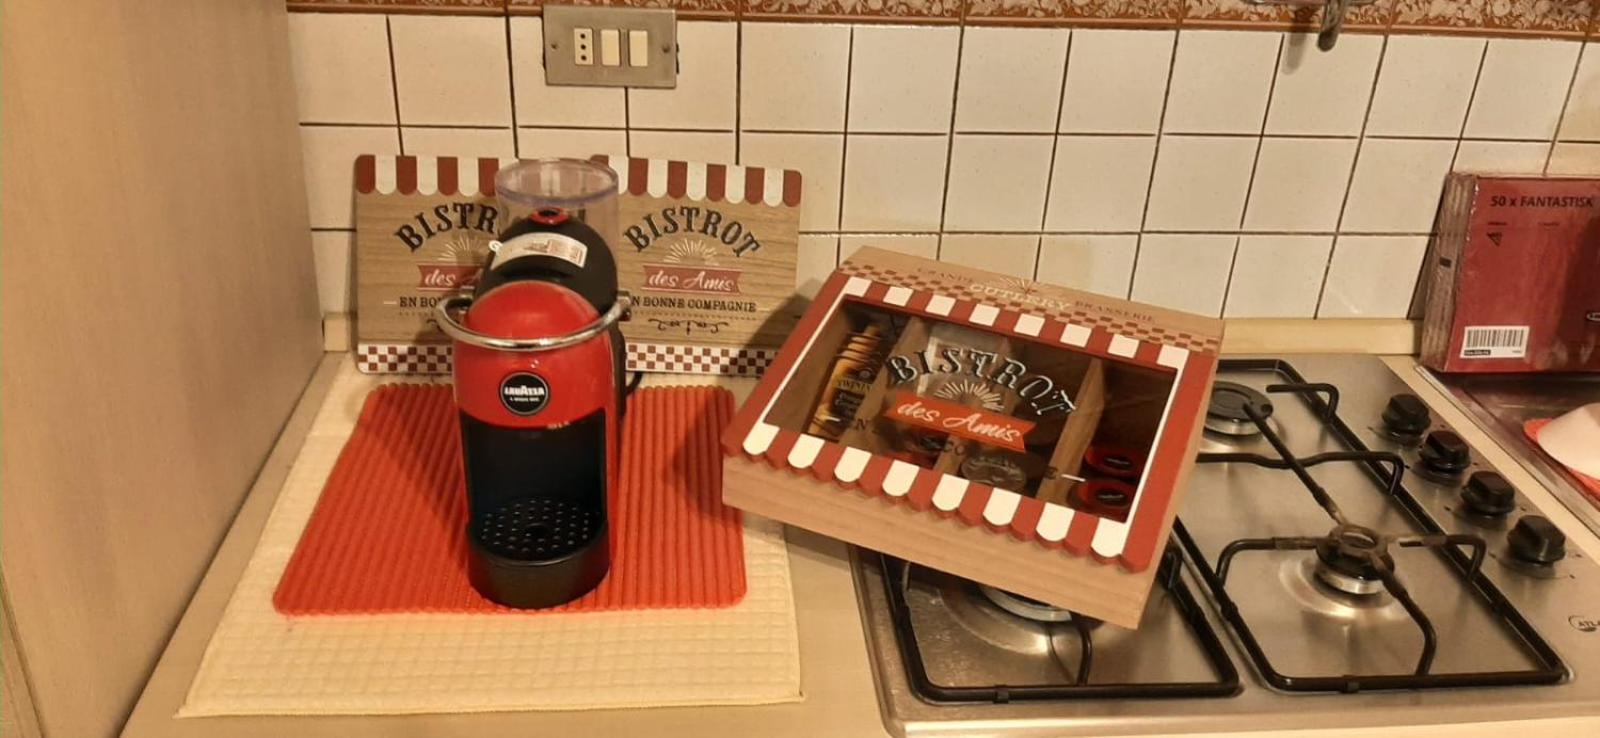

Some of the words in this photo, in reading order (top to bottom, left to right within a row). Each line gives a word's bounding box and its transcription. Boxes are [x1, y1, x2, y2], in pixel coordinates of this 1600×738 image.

[1490, 195, 1506, 207] 50
[1509, 197, 1517, 207] x
[1520, 195, 1593, 208] FANTASTISK
[394, 202, 498, 253] BISTR
[623, 206, 761, 258] BISTROT
[424, 268, 456, 286] des
[648, 270, 679, 288] des
[683, 271, 734, 292] Amis
[400, 296, 417, 308] EN
[643, 296, 685, 309] BONNE
[687, 299, 757, 313] COMPAGNIE
[884, 348, 1077, 417] BISTROT
[897, 400, 940, 423] des
[942, 412, 1022, 442] Amis
